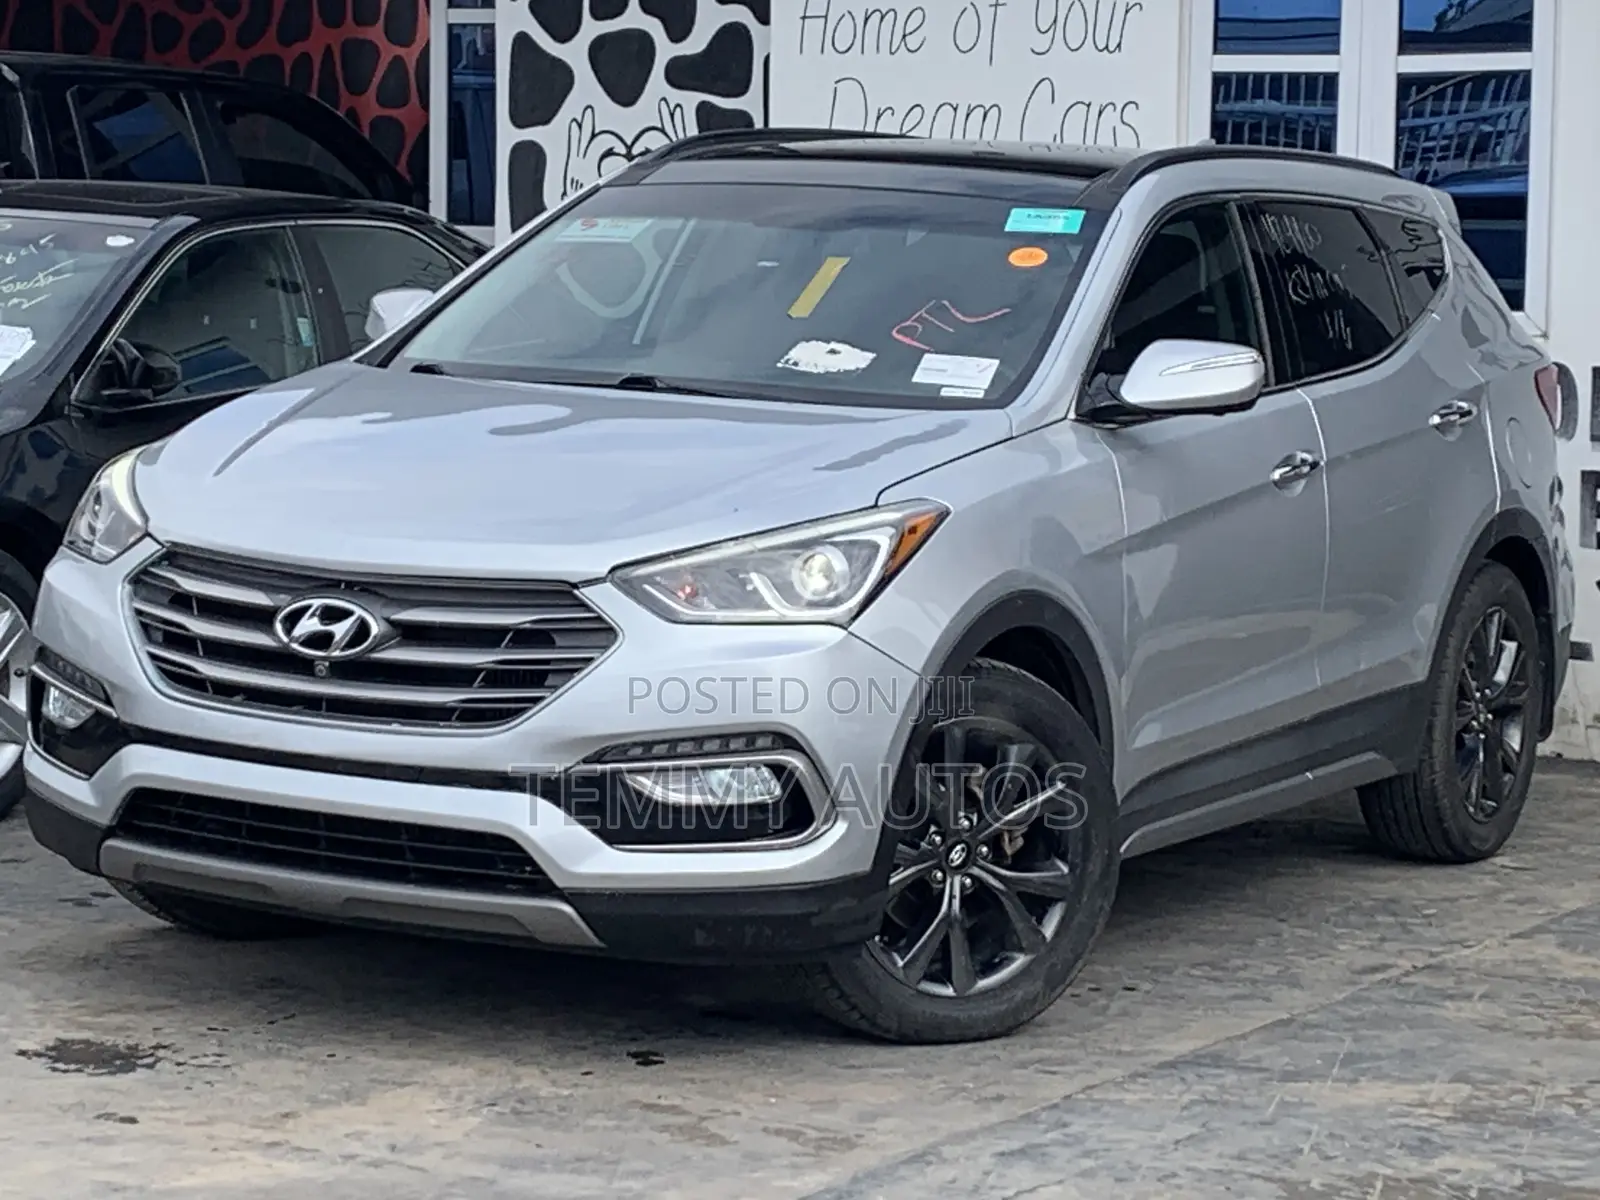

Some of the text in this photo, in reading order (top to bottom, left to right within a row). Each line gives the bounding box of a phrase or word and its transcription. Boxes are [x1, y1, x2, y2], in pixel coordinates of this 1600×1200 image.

[799, 0, 927, 55] Home
[953, 0, 1008, 65] of
[829, 76, 1141, 149] Dream Cars
